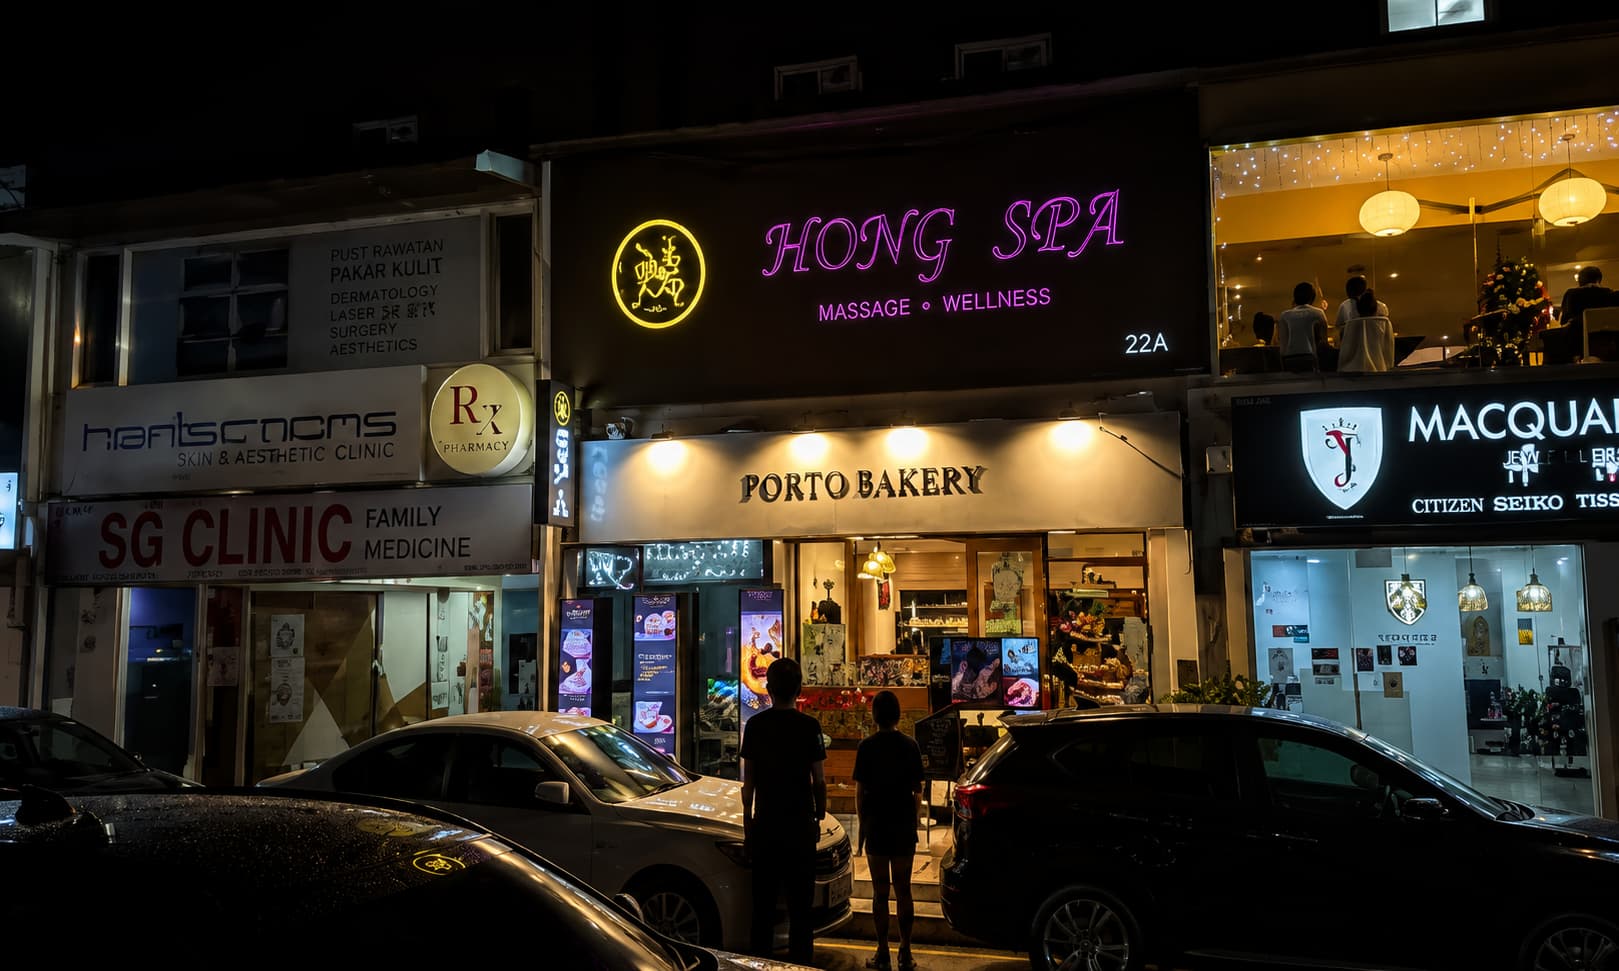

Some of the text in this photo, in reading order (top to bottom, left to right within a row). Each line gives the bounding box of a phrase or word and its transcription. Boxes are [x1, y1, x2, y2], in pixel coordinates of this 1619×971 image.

[762, 189, 1124, 282] HONG SPA
[330, 240, 443, 261] PUST RAWATAN
[331, 257, 442, 282] PAKAR KULIT
[331, 284, 438, 304] DERMATOLOGY
[819, 288, 1050, 321] MASSAGE WELLNESS
[330, 307, 375, 321] LASER
[329, 322, 397, 339] SURGERY
[329, 338, 417, 355] AESTHETICS
[1125, 332, 1168, 354] 22A
[177, 442, 395, 467] SKIN & AESTHETIC CLINIC
[443, 441, 509, 453] PHARMACY
[743, 465, 986, 503] PORTO BAKERY
[1412, 498, 1484, 514] CITIZEN
[1494, 495, 1564, 512] SEIKO
[366, 506, 441, 528] FAMILY
[99, 503, 352, 569] SG CLINIC
[365, 537, 471, 560] MEDICINE
